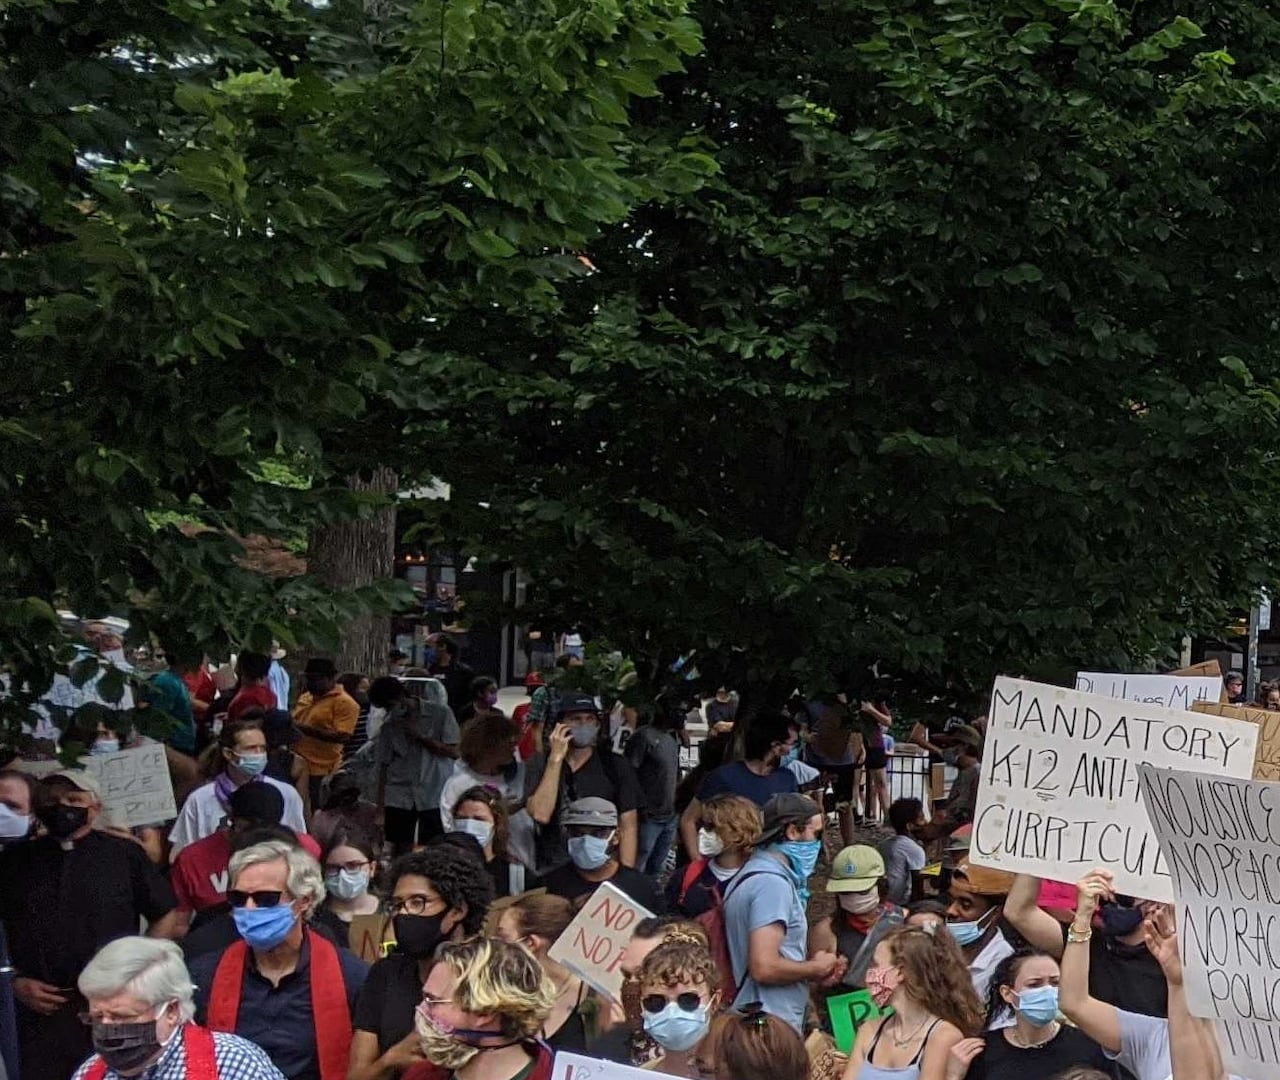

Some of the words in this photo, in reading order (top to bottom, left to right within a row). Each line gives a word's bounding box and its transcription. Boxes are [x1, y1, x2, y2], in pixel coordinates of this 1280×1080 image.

[990, 688, 1241, 768] MANDATORY
[1144, 773, 1195, 838] NO
[976, 803, 1171, 877] CURRICUL
[1168, 842, 1219, 899] NO
[590, 898, 636, 931] NO
[1183, 905, 1228, 967] NO
[573, 927, 613, 965] NO
